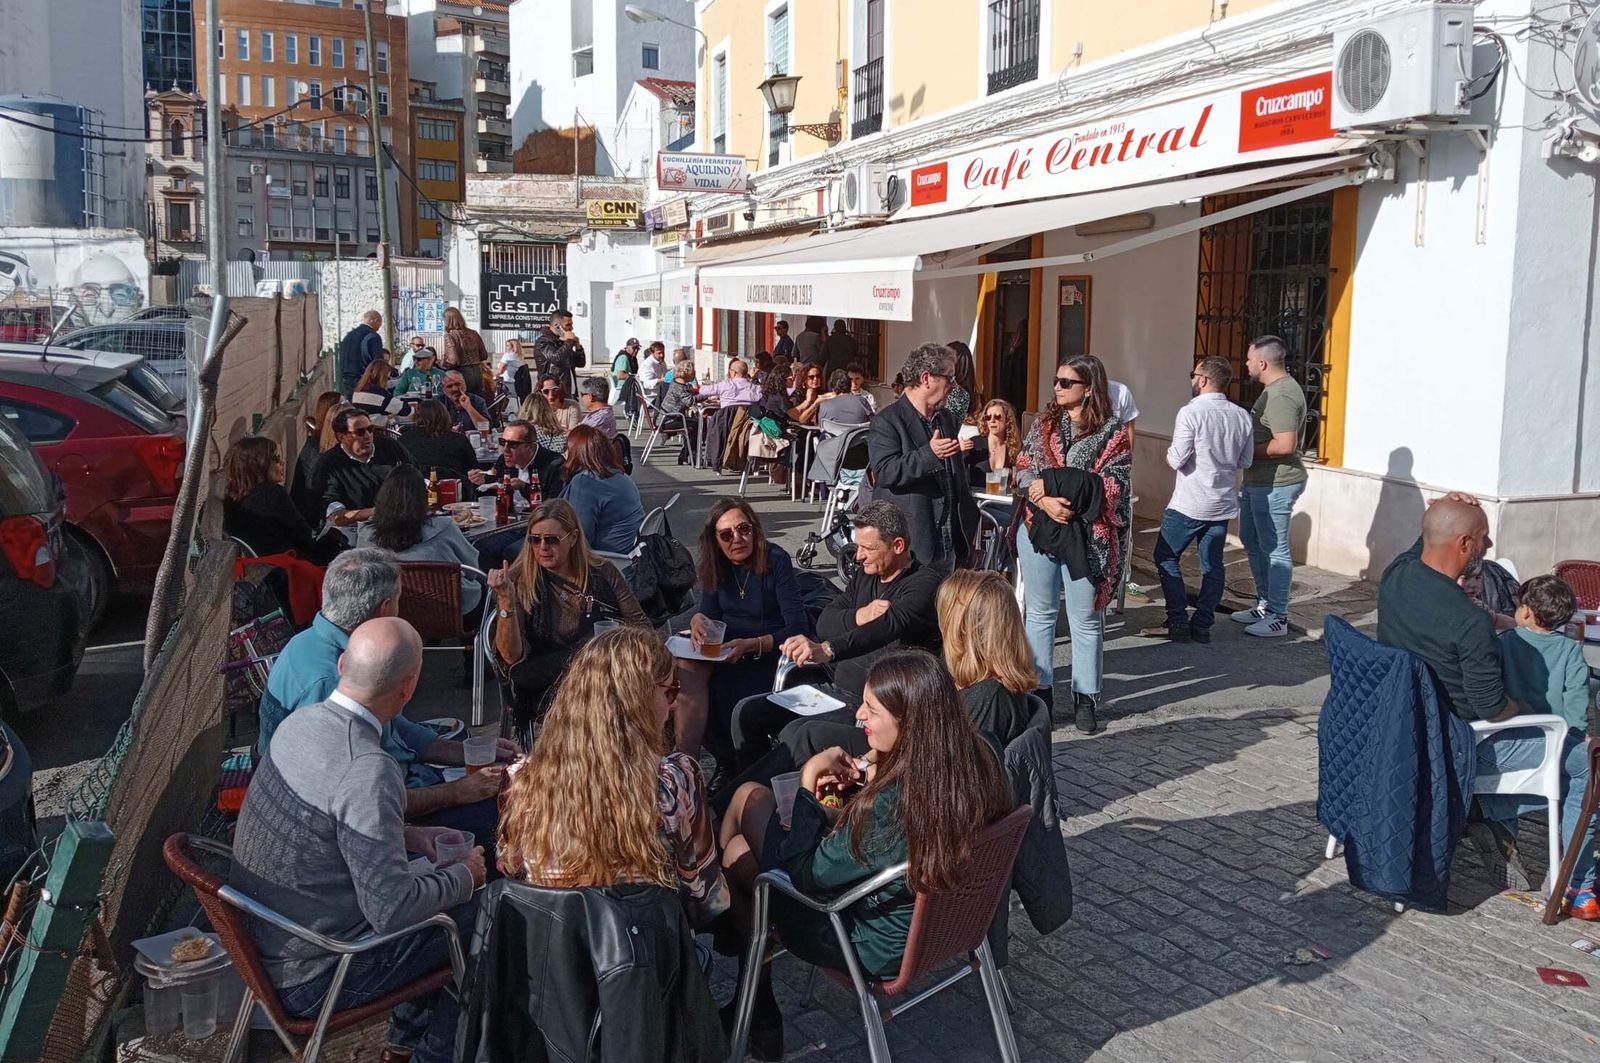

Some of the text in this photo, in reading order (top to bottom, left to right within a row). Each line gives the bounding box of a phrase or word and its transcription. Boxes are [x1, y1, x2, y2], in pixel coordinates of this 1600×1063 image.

[1256, 88, 1324, 117] Cruzcampo
[1072, 128, 1100, 146] Fundado
[1109, 122, 1126, 136] 1913
[963, 103, 1214, 190] Café Central
[686, 165, 731, 176] AQUILINO
[694, 178, 722, 188] VIDAL
[603, 202, 637, 214] CNN
[746, 284, 752, 303] LA
[791, 284, 799, 305] EN
[799, 284, 813, 306] 1913
[872, 285, 901, 301] Cruzcampo
[490, 301, 558, 314] GESTIA
